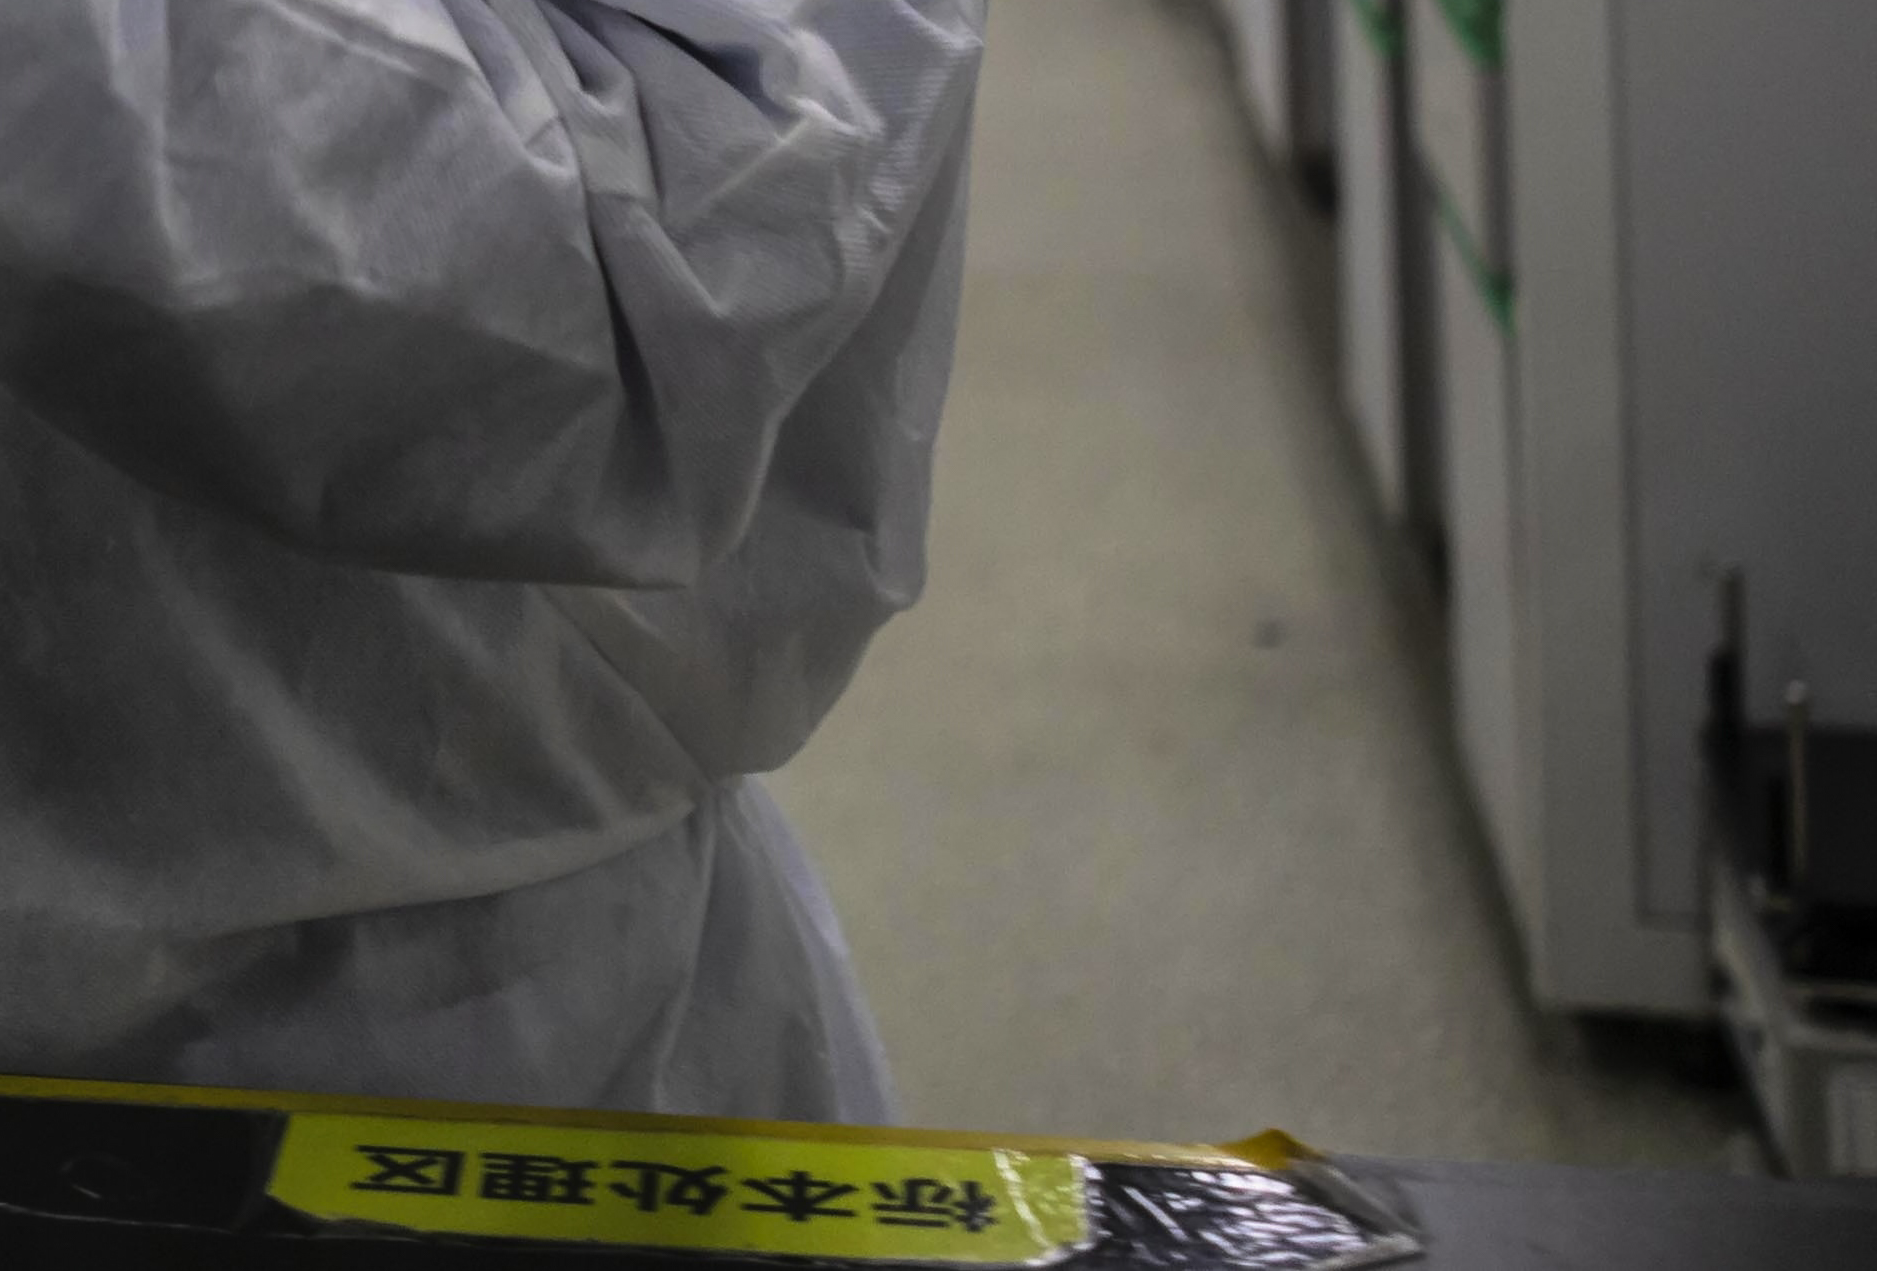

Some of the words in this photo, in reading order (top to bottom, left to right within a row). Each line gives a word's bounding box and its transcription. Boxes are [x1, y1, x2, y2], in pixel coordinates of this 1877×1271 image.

[348, 1141, 1000, 1234] 标本处理区
